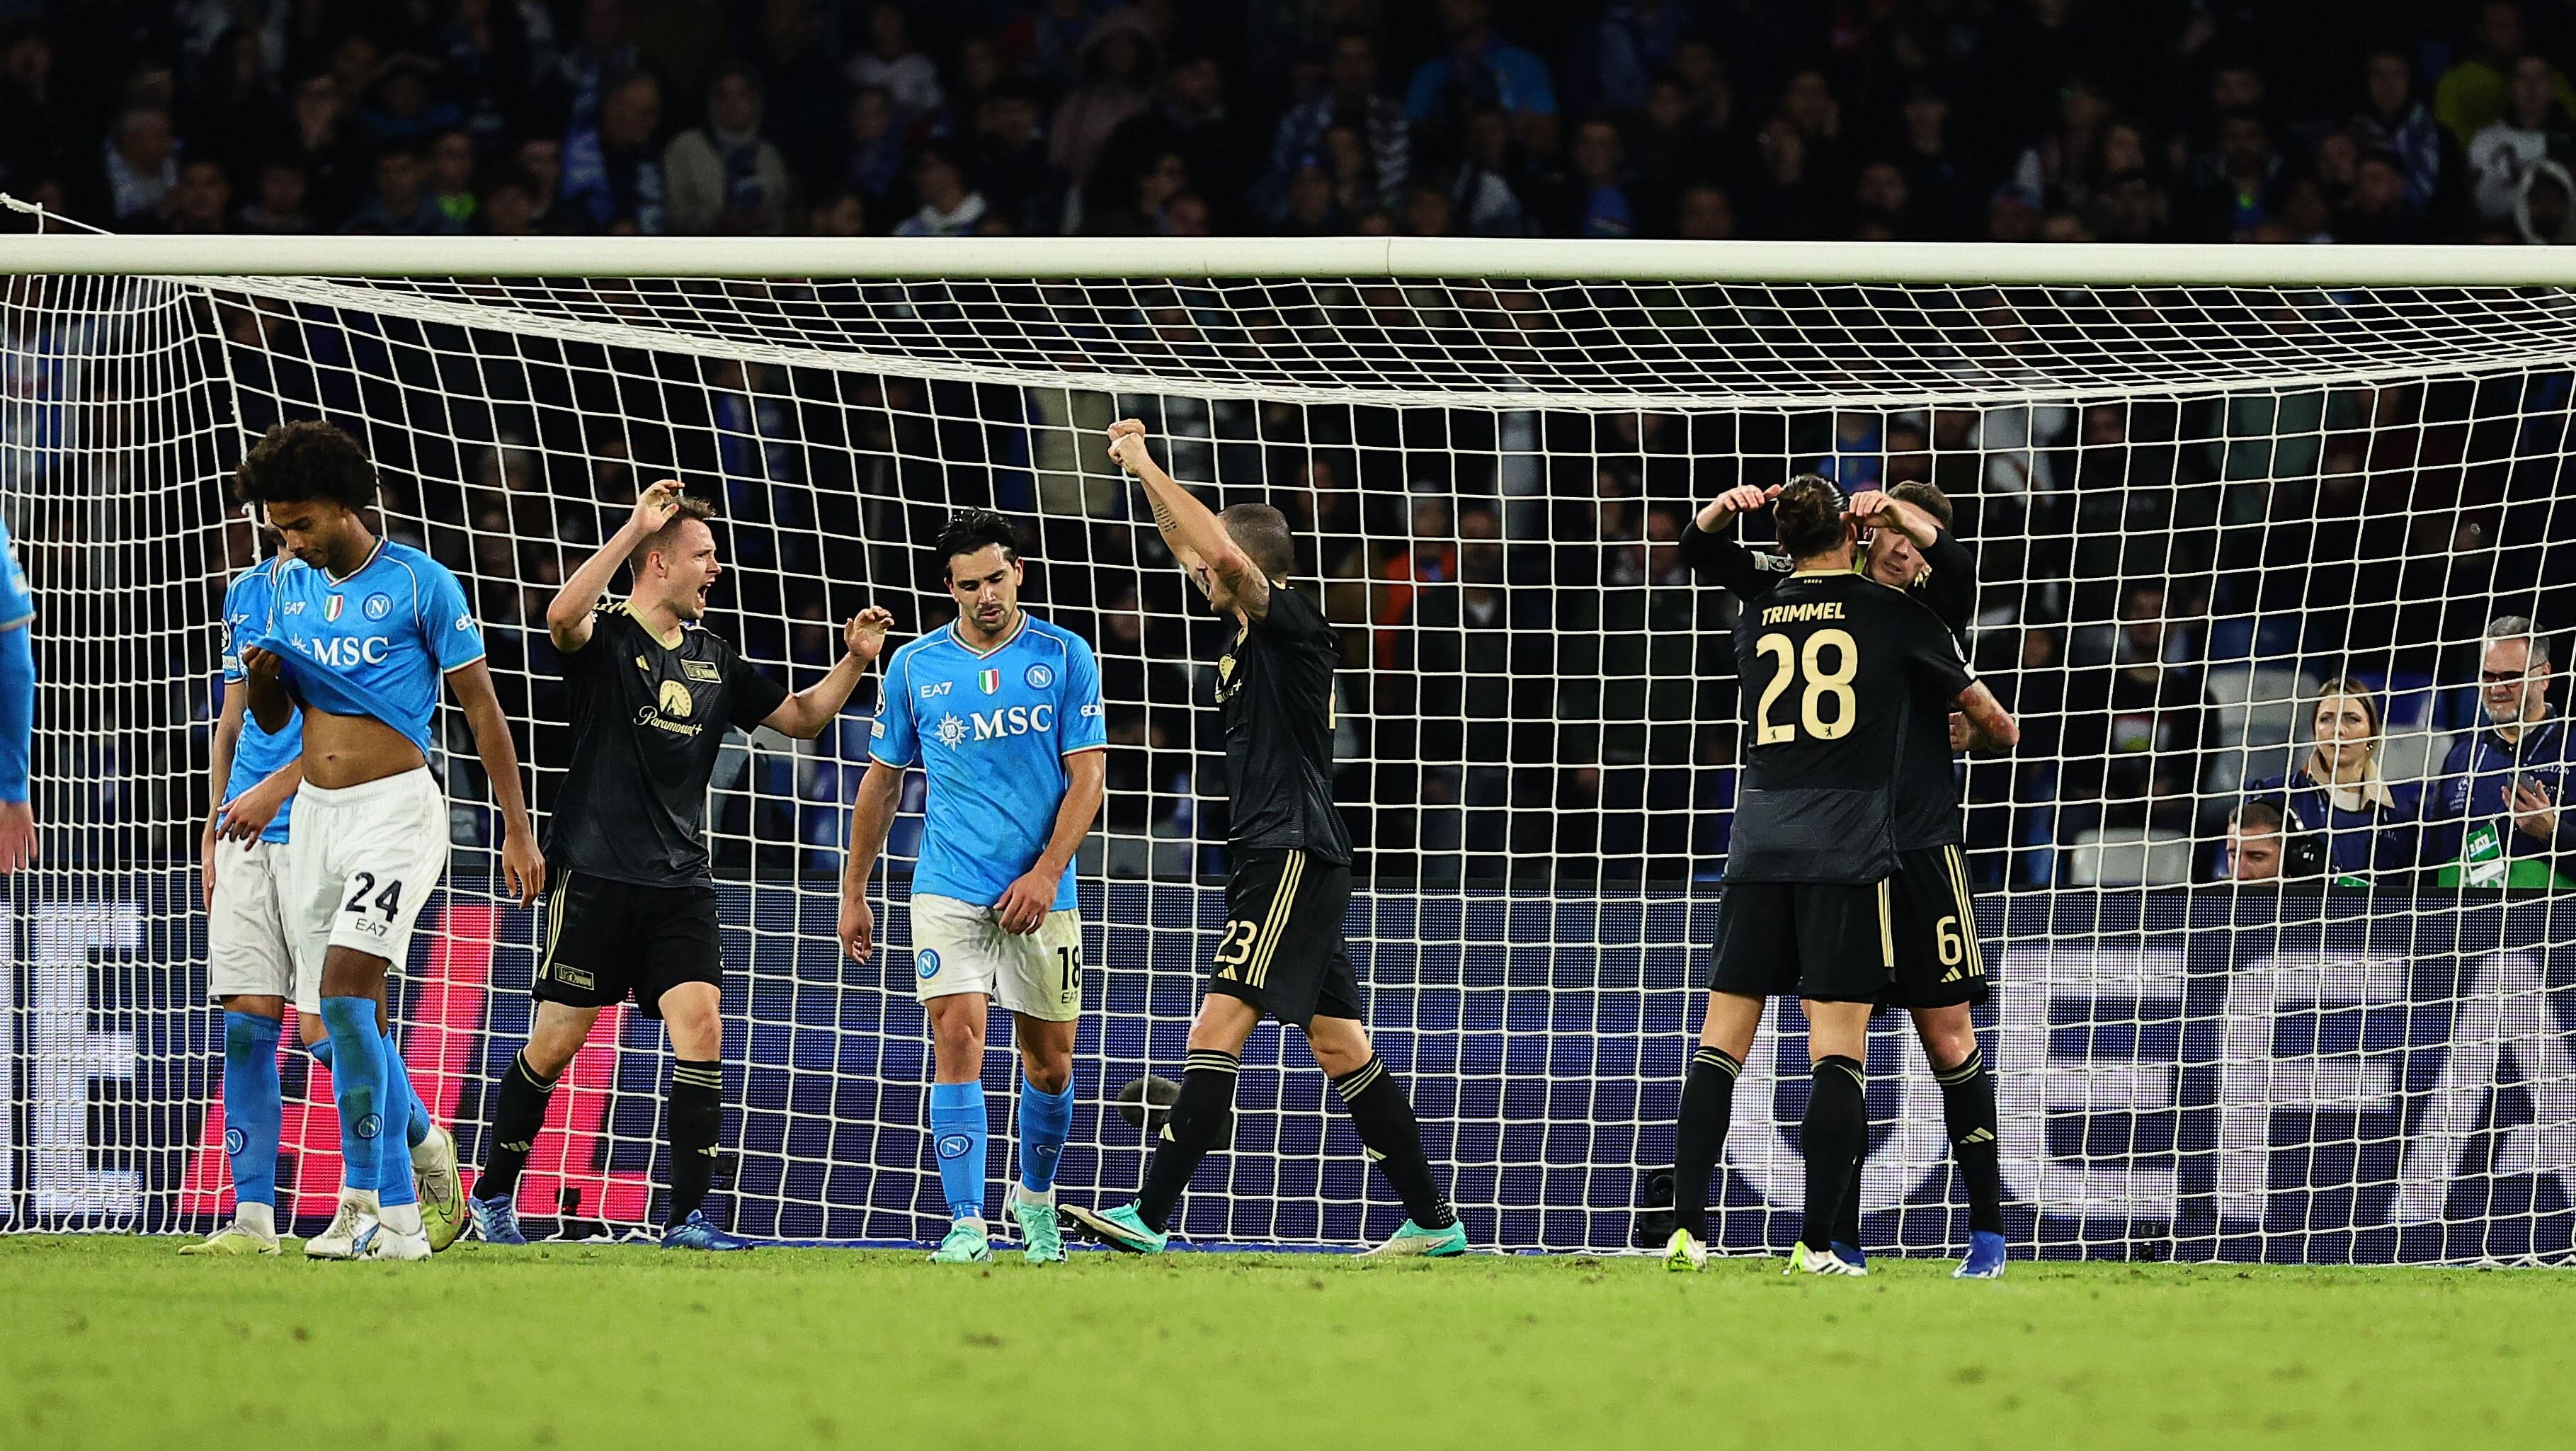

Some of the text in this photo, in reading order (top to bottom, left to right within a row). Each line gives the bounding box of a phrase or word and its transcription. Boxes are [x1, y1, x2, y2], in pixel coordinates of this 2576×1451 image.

[283, 601, 307, 615] EA7
[1762, 602, 1846, 627] TRIMMEL
[311, 636, 389, 666] MSC
[921, 681, 954, 699] EA7
[1756, 628, 1858, 746] 28
[969, 704, 1053, 741] MSC
[345, 871, 402, 923] 24
[355, 918, 389, 937] EA7
[1213, 920, 1258, 965] 23
[1936, 916, 1963, 966] 6
[1057, 945, 1081, 990] 18
